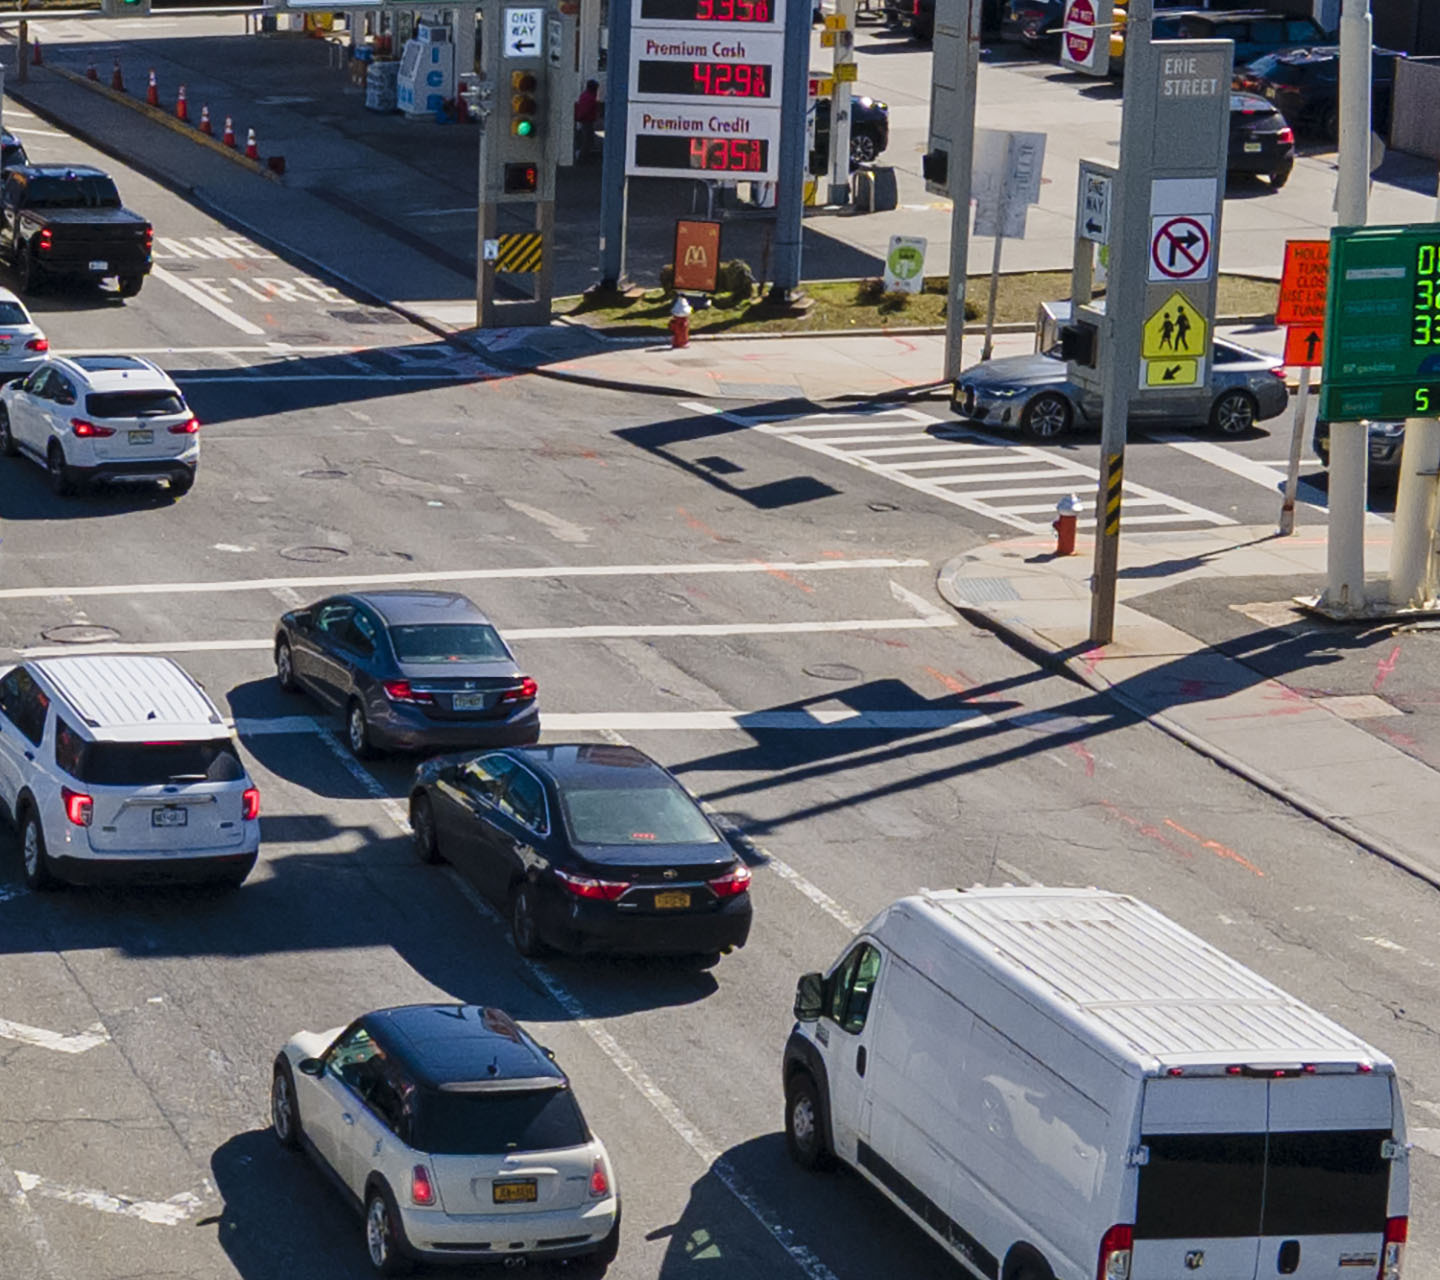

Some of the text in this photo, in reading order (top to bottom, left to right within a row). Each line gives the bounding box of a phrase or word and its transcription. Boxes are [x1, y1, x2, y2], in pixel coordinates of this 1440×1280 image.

[511, 12, 536, 24] ONE
[646, 40, 746, 58] Premium Cash
[1165, 58, 1197, 74] ERIE
[1164, 78, 1218, 96] STREET
[642, 115, 750, 133] Premium Credit
[186, 277, 357, 305] FIRE
